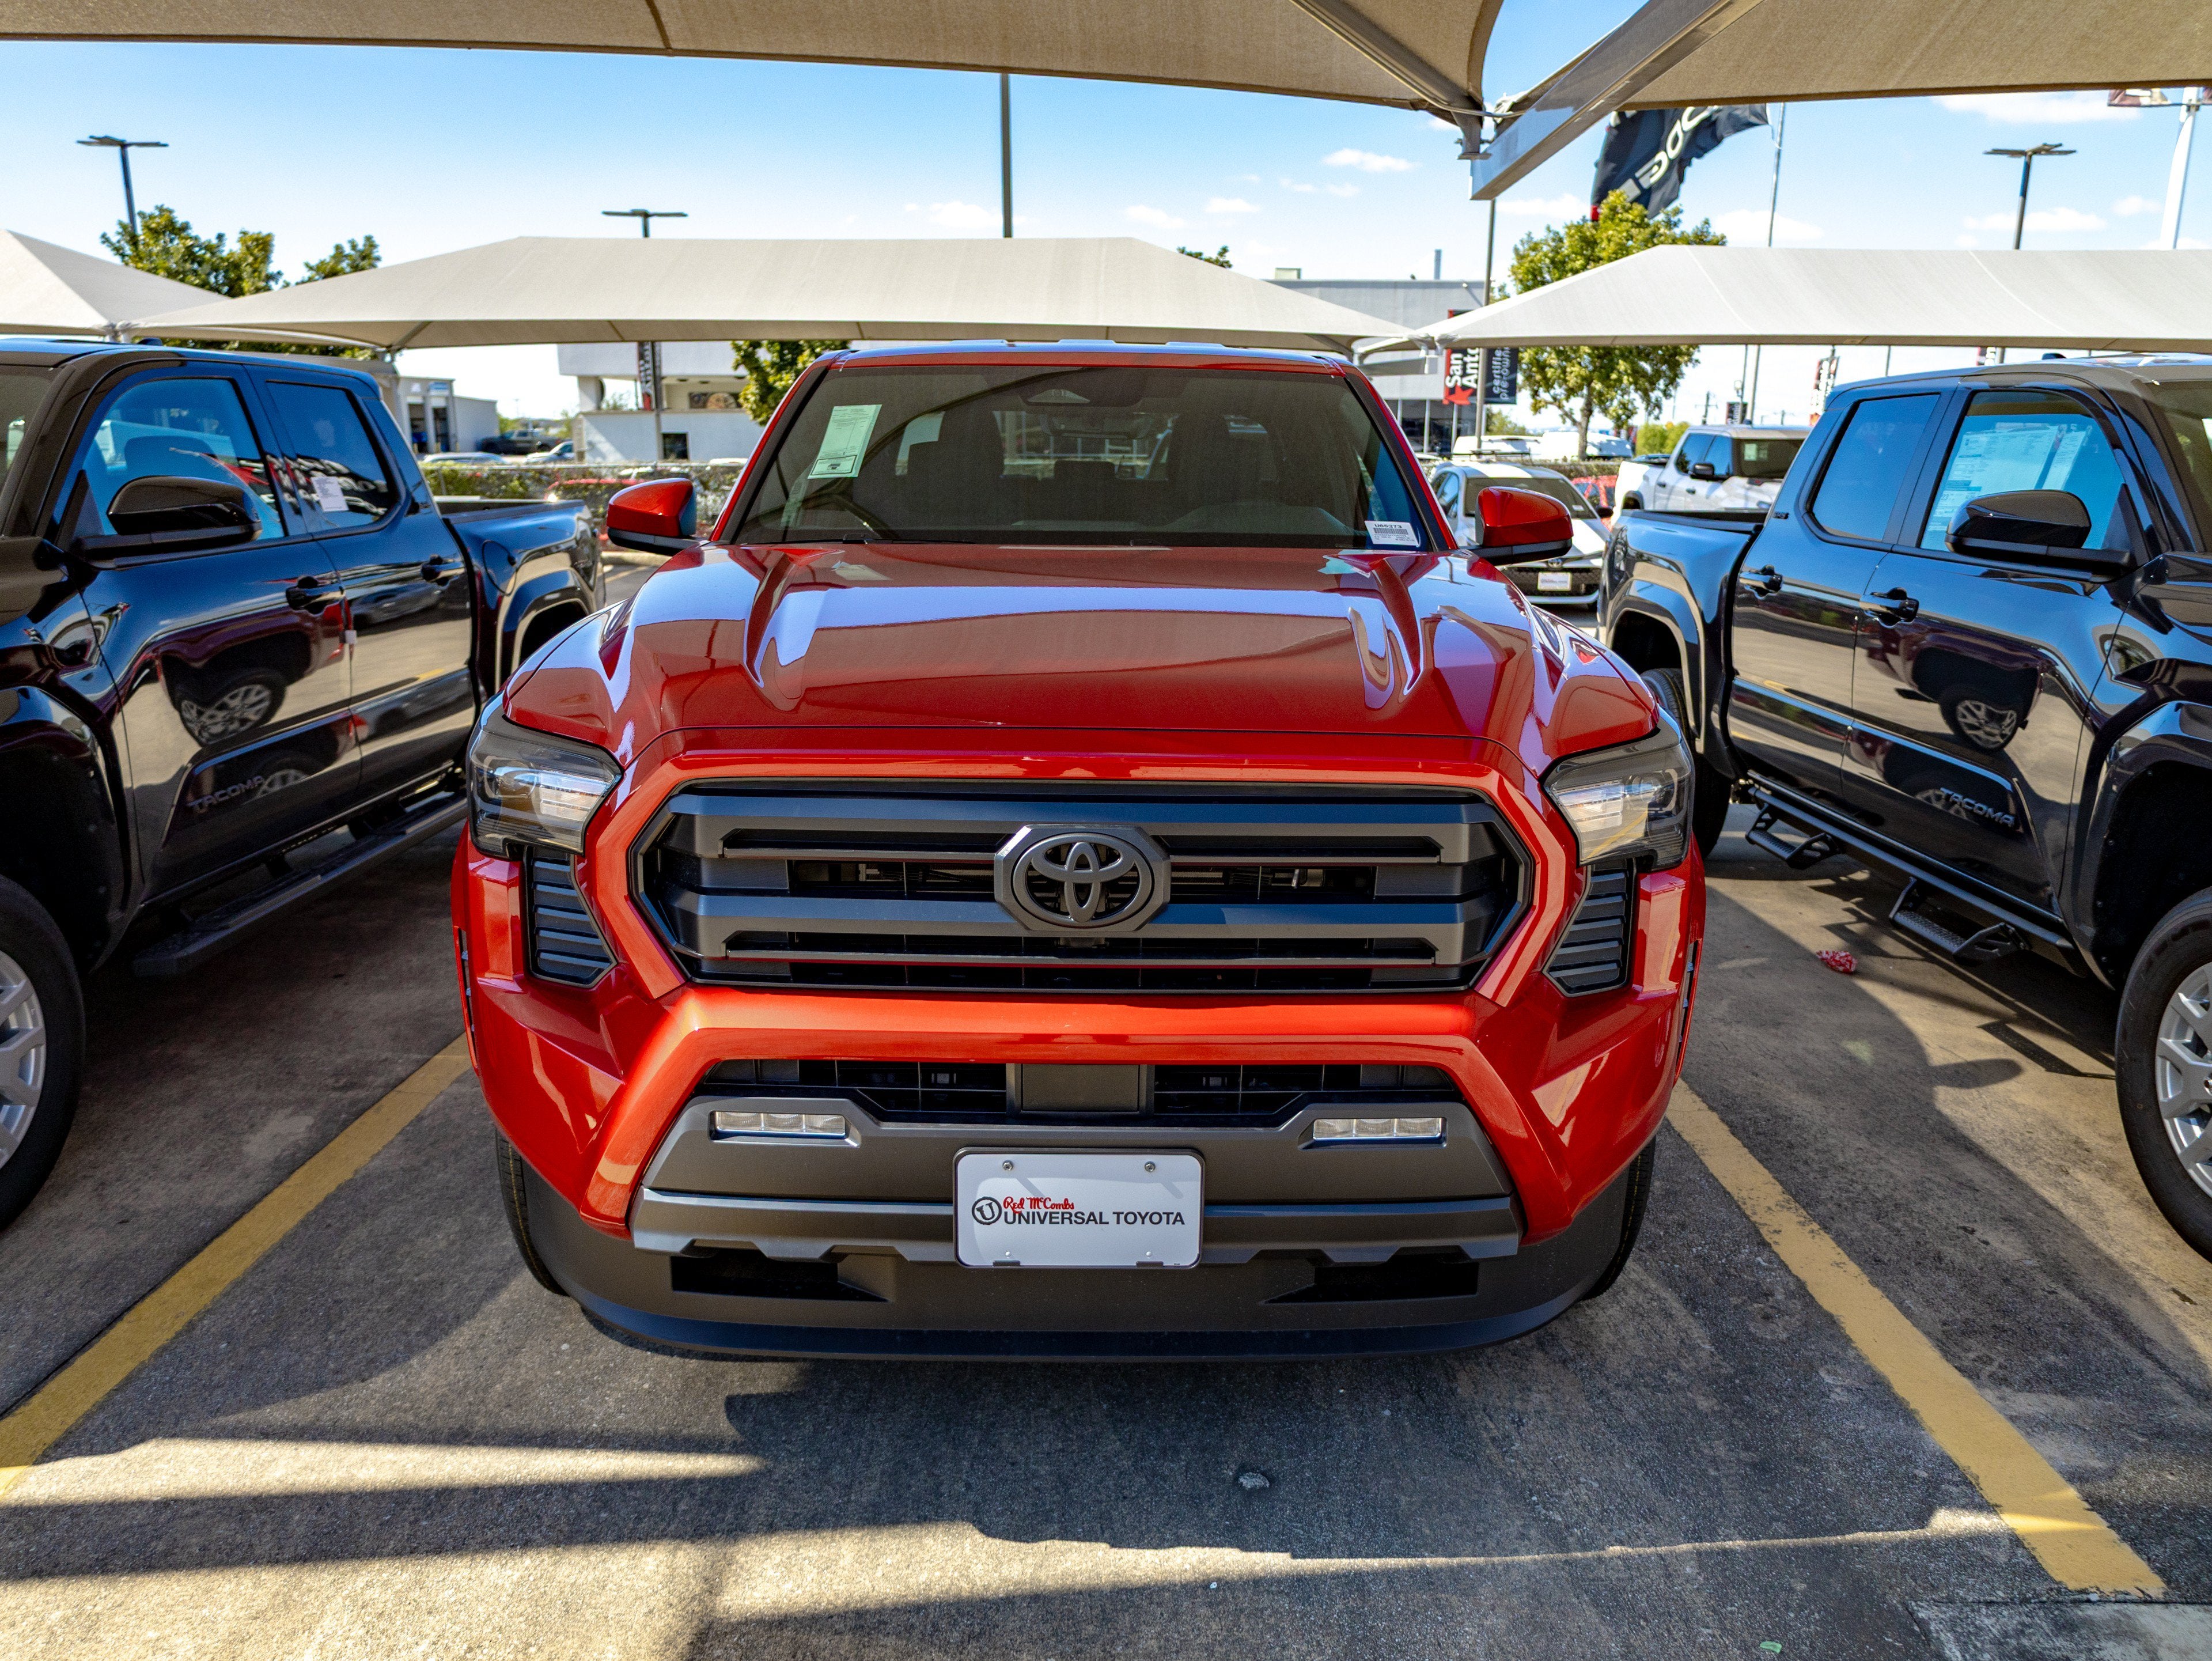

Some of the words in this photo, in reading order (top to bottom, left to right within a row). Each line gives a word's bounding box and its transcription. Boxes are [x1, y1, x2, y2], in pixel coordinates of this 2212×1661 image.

[1445, 353, 1464, 388] San
[187, 775, 264, 811] TACOMA
[1940, 787, 2015, 827] TACOMA
[1003, 1196, 1025, 1214] Red
[1026, 1197, 1075, 1210] McCombs
[1003, 1210, 1109, 1225] UNIVERSAL
[1112, 1211, 1185, 1225] TOYOTA
